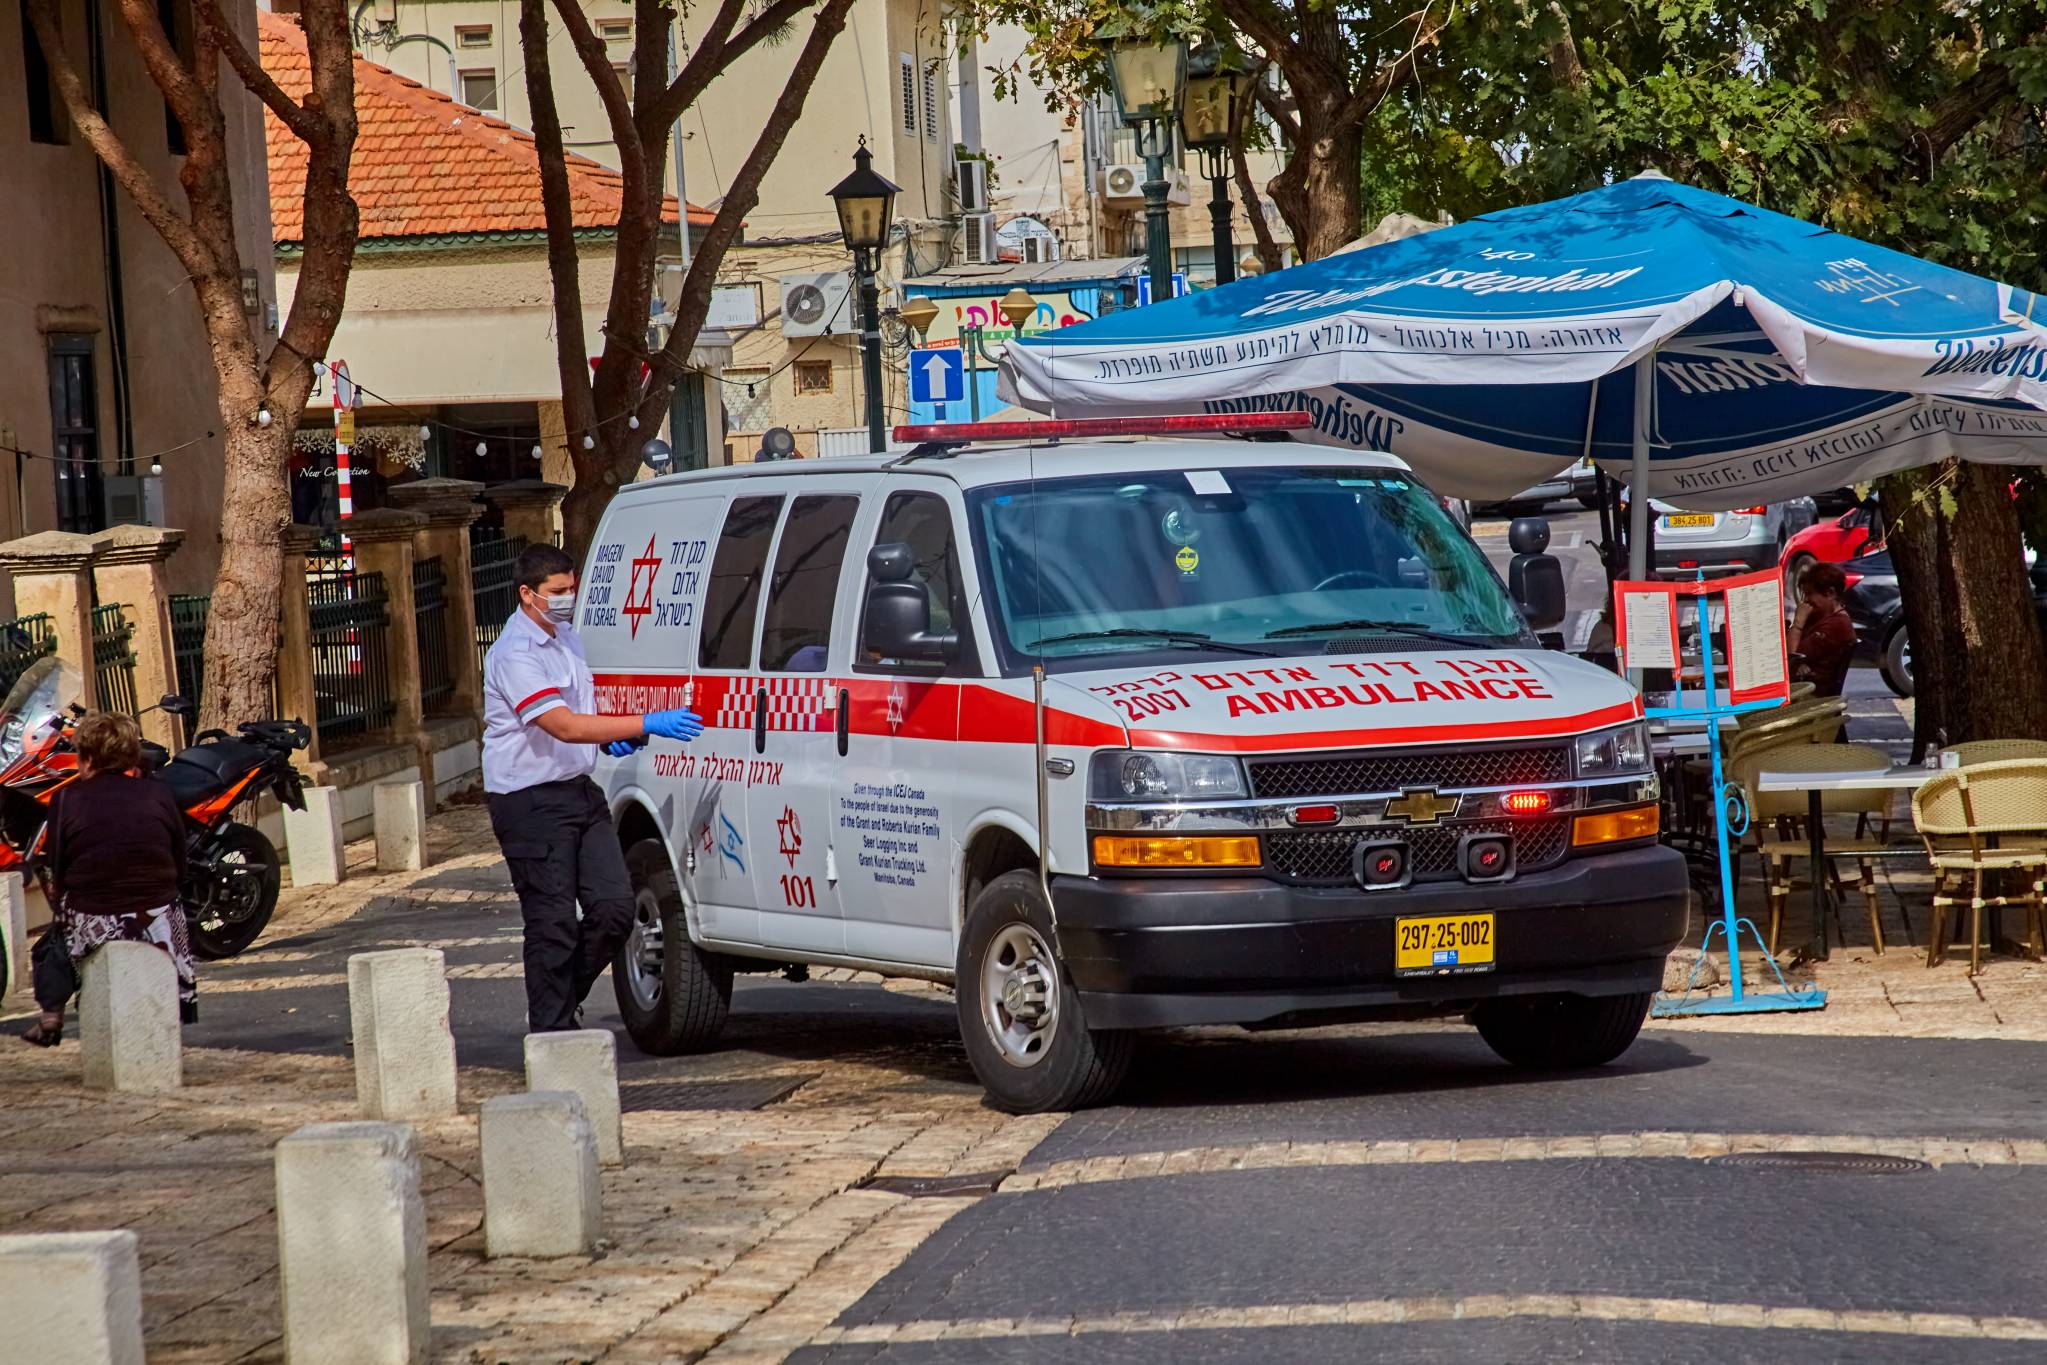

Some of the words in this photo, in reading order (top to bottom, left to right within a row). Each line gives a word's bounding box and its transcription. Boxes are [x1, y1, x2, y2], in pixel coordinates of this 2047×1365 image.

[1237, 330, 1300, 361] להימנע
[1311, 322, 1369, 351] מומלץ
[1394, 325, 1473, 349] אלכוהול
[1483, 327, 1530, 349] מכיל
[1541, 326, 1623, 348] אזהרה:
[1169, 345, 1228, 369] משתיה
[300, 466, 322, 478] New
[324, 466, 371, 477] Cotion
[596, 544, 625, 562] MAGEN
[671, 542, 688, 565] דוד
[686, 541, 706, 569] מגן
[591, 565, 615, 583] DAVID
[672, 571, 700, 595] אדום
[587, 586, 611, 605] ADOM
[584, 608, 592, 626] IN
[593, 608, 617, 626] ISRAEL
[655, 598, 693, 627] בישראל
[1190, 667, 1319, 691] אדום
[1329, 661, 1422, 678] דוד
[1435, 659, 1529, 678] מגן
[1088, 671, 1183, 695] כרמל
[627, 686, 648, 714] MAGEN
[1113, 689, 1191, 722] 2007
[1227, 679, 1553, 718] AMBULANCE
[654, 750, 696, 778] הלאומי
[700, 752, 744, 782] ההצלה
[747, 760, 783, 789] ארגון
[854, 783, 867, 794] Given
[867, 784, 885, 799] through
[885, 786, 893, 795] the
[893, 784, 907, 799] ICEJ
[907, 788, 925, 800] Canada
[855, 801, 870, 813] people
[871, 802, 876, 811] of
[890, 803, 899, 814] due
[899, 804, 905, 814] to
[905, 803, 913, 815] the
[914, 806, 939, 820] generosity
[840, 815, 846, 827] of
[847, 816, 855, 828] the
[856, 816, 871, 830] Grant
[871, 818, 881, 830] and
[881, 819, 903, 834] Roberta
[903, 820, 921, 835] Kurian
[922, 822, 940, 840] Family
[876, 837, 898, 854] Logging
[907, 841, 918, 853] and
[859, 853, 874, 868] Grant
[874, 855, 891, 869] Kurian
[891, 857, 915, 875] Trucking
[780, 874, 816, 908] 101
[897, 874, 915, 887] Canada
